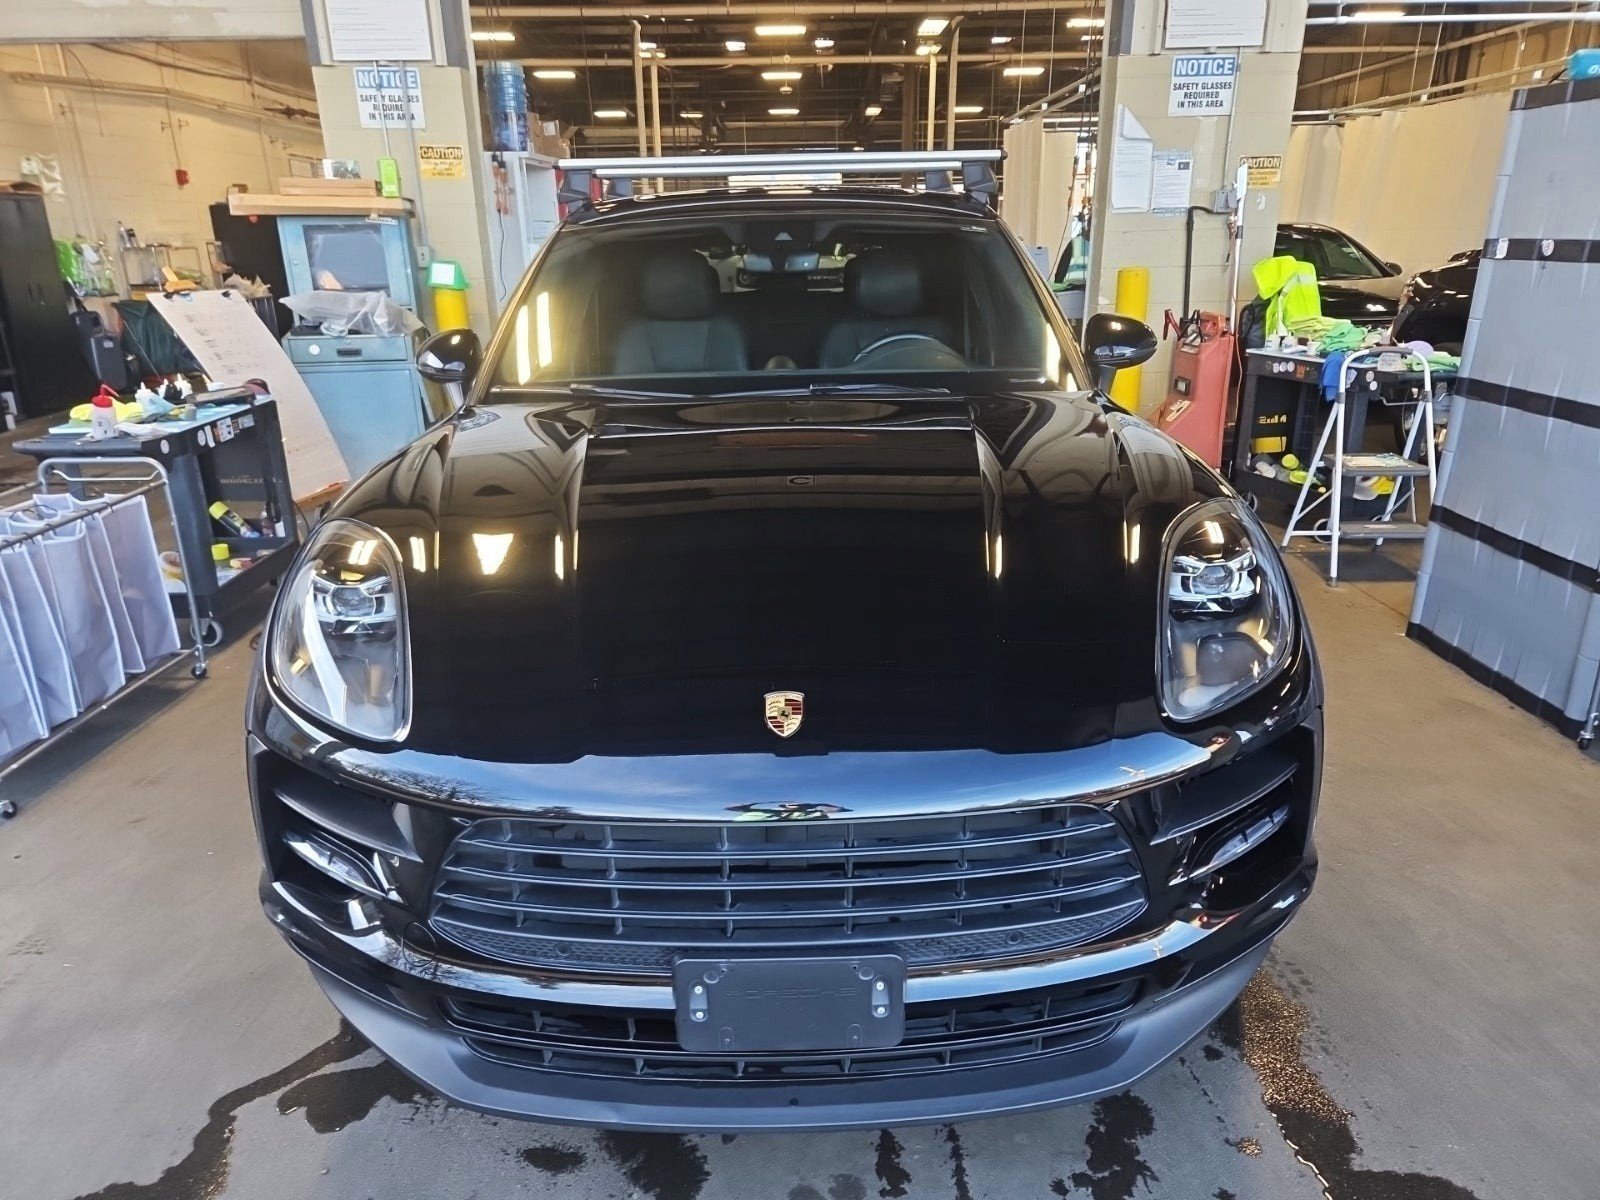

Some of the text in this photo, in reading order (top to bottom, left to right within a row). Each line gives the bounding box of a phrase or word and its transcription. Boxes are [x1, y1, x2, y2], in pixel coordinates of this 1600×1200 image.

[1176, 59, 1234, 75] NOTICE
[1173, 82, 1232, 91] SAFETY GLASSES
[360, 94, 420, 103] SAFEY GLASES
[1184, 91, 1220, 99] REQUIRED
[1187, 100, 1204, 108] THIS
[1205, 100, 1224, 108] AREA
[397, 113, 416, 121] ARA
[421, 148, 462, 158] CAUTION
